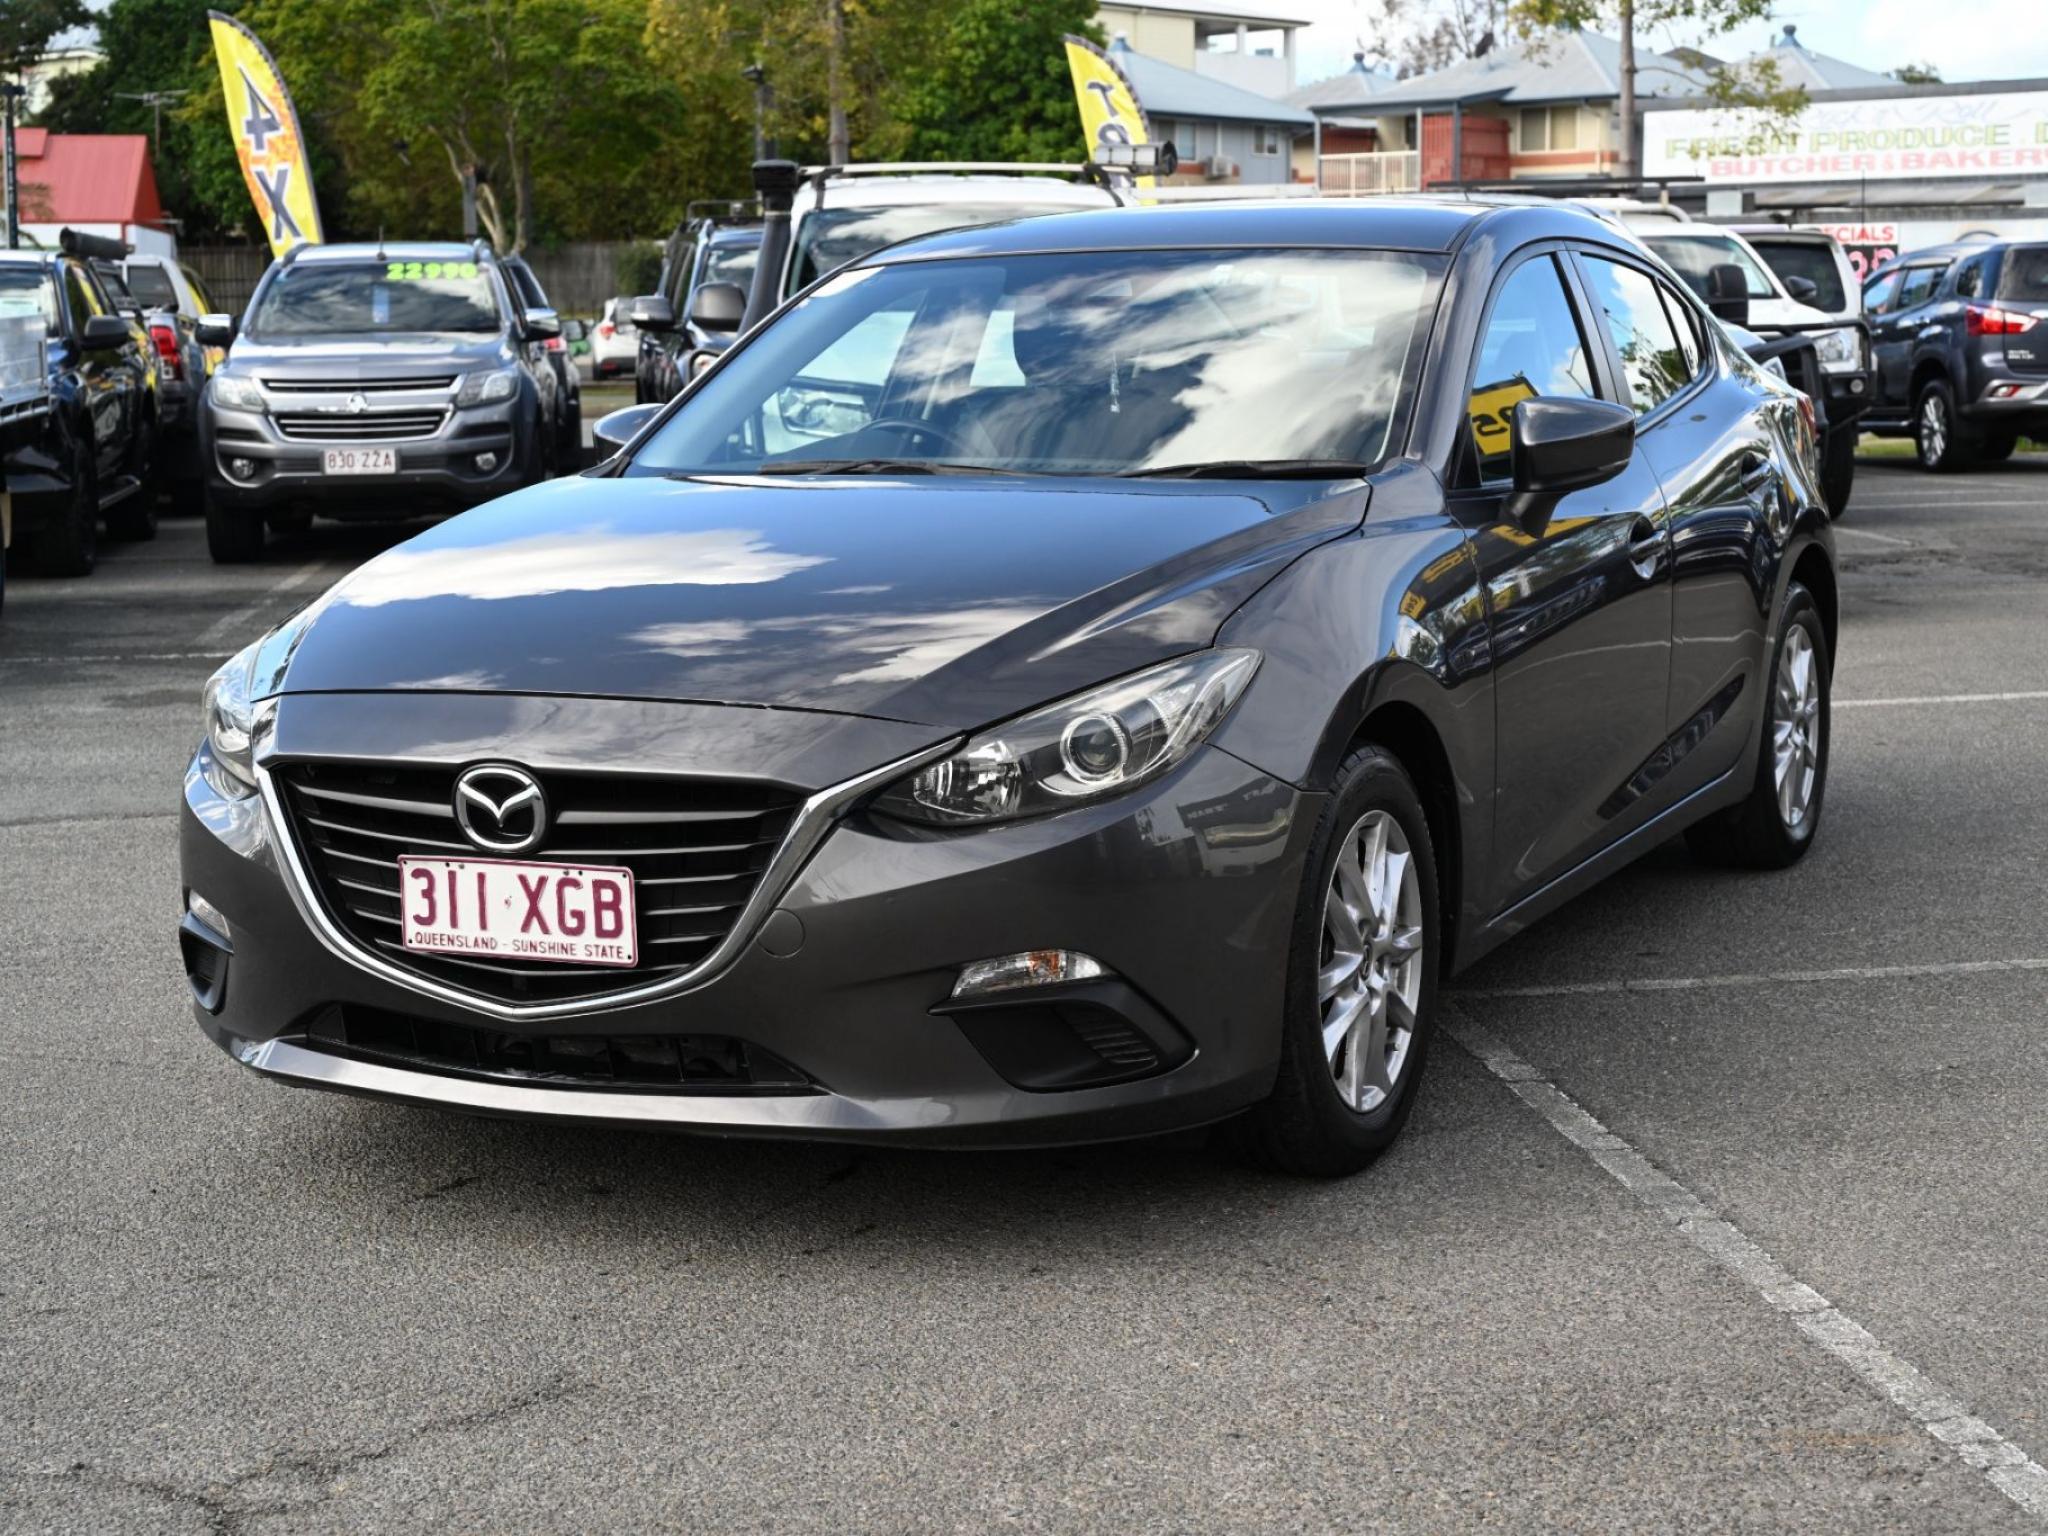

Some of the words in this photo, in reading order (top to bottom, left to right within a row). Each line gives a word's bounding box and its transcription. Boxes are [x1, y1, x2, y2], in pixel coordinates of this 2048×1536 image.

[1665, 132, 1798, 160] FRESH
[1810, 124, 2010, 153] PRODUCE
[1711, 153, 1876, 177] BUTCHER
[411, 868, 488, 931] 311
[517, 874, 624, 939] XGB
[415, 932, 498, 950] QUEENSLAND
[512, 939, 577, 957] SUNSHINE
[585, 944, 624, 959] STATE
